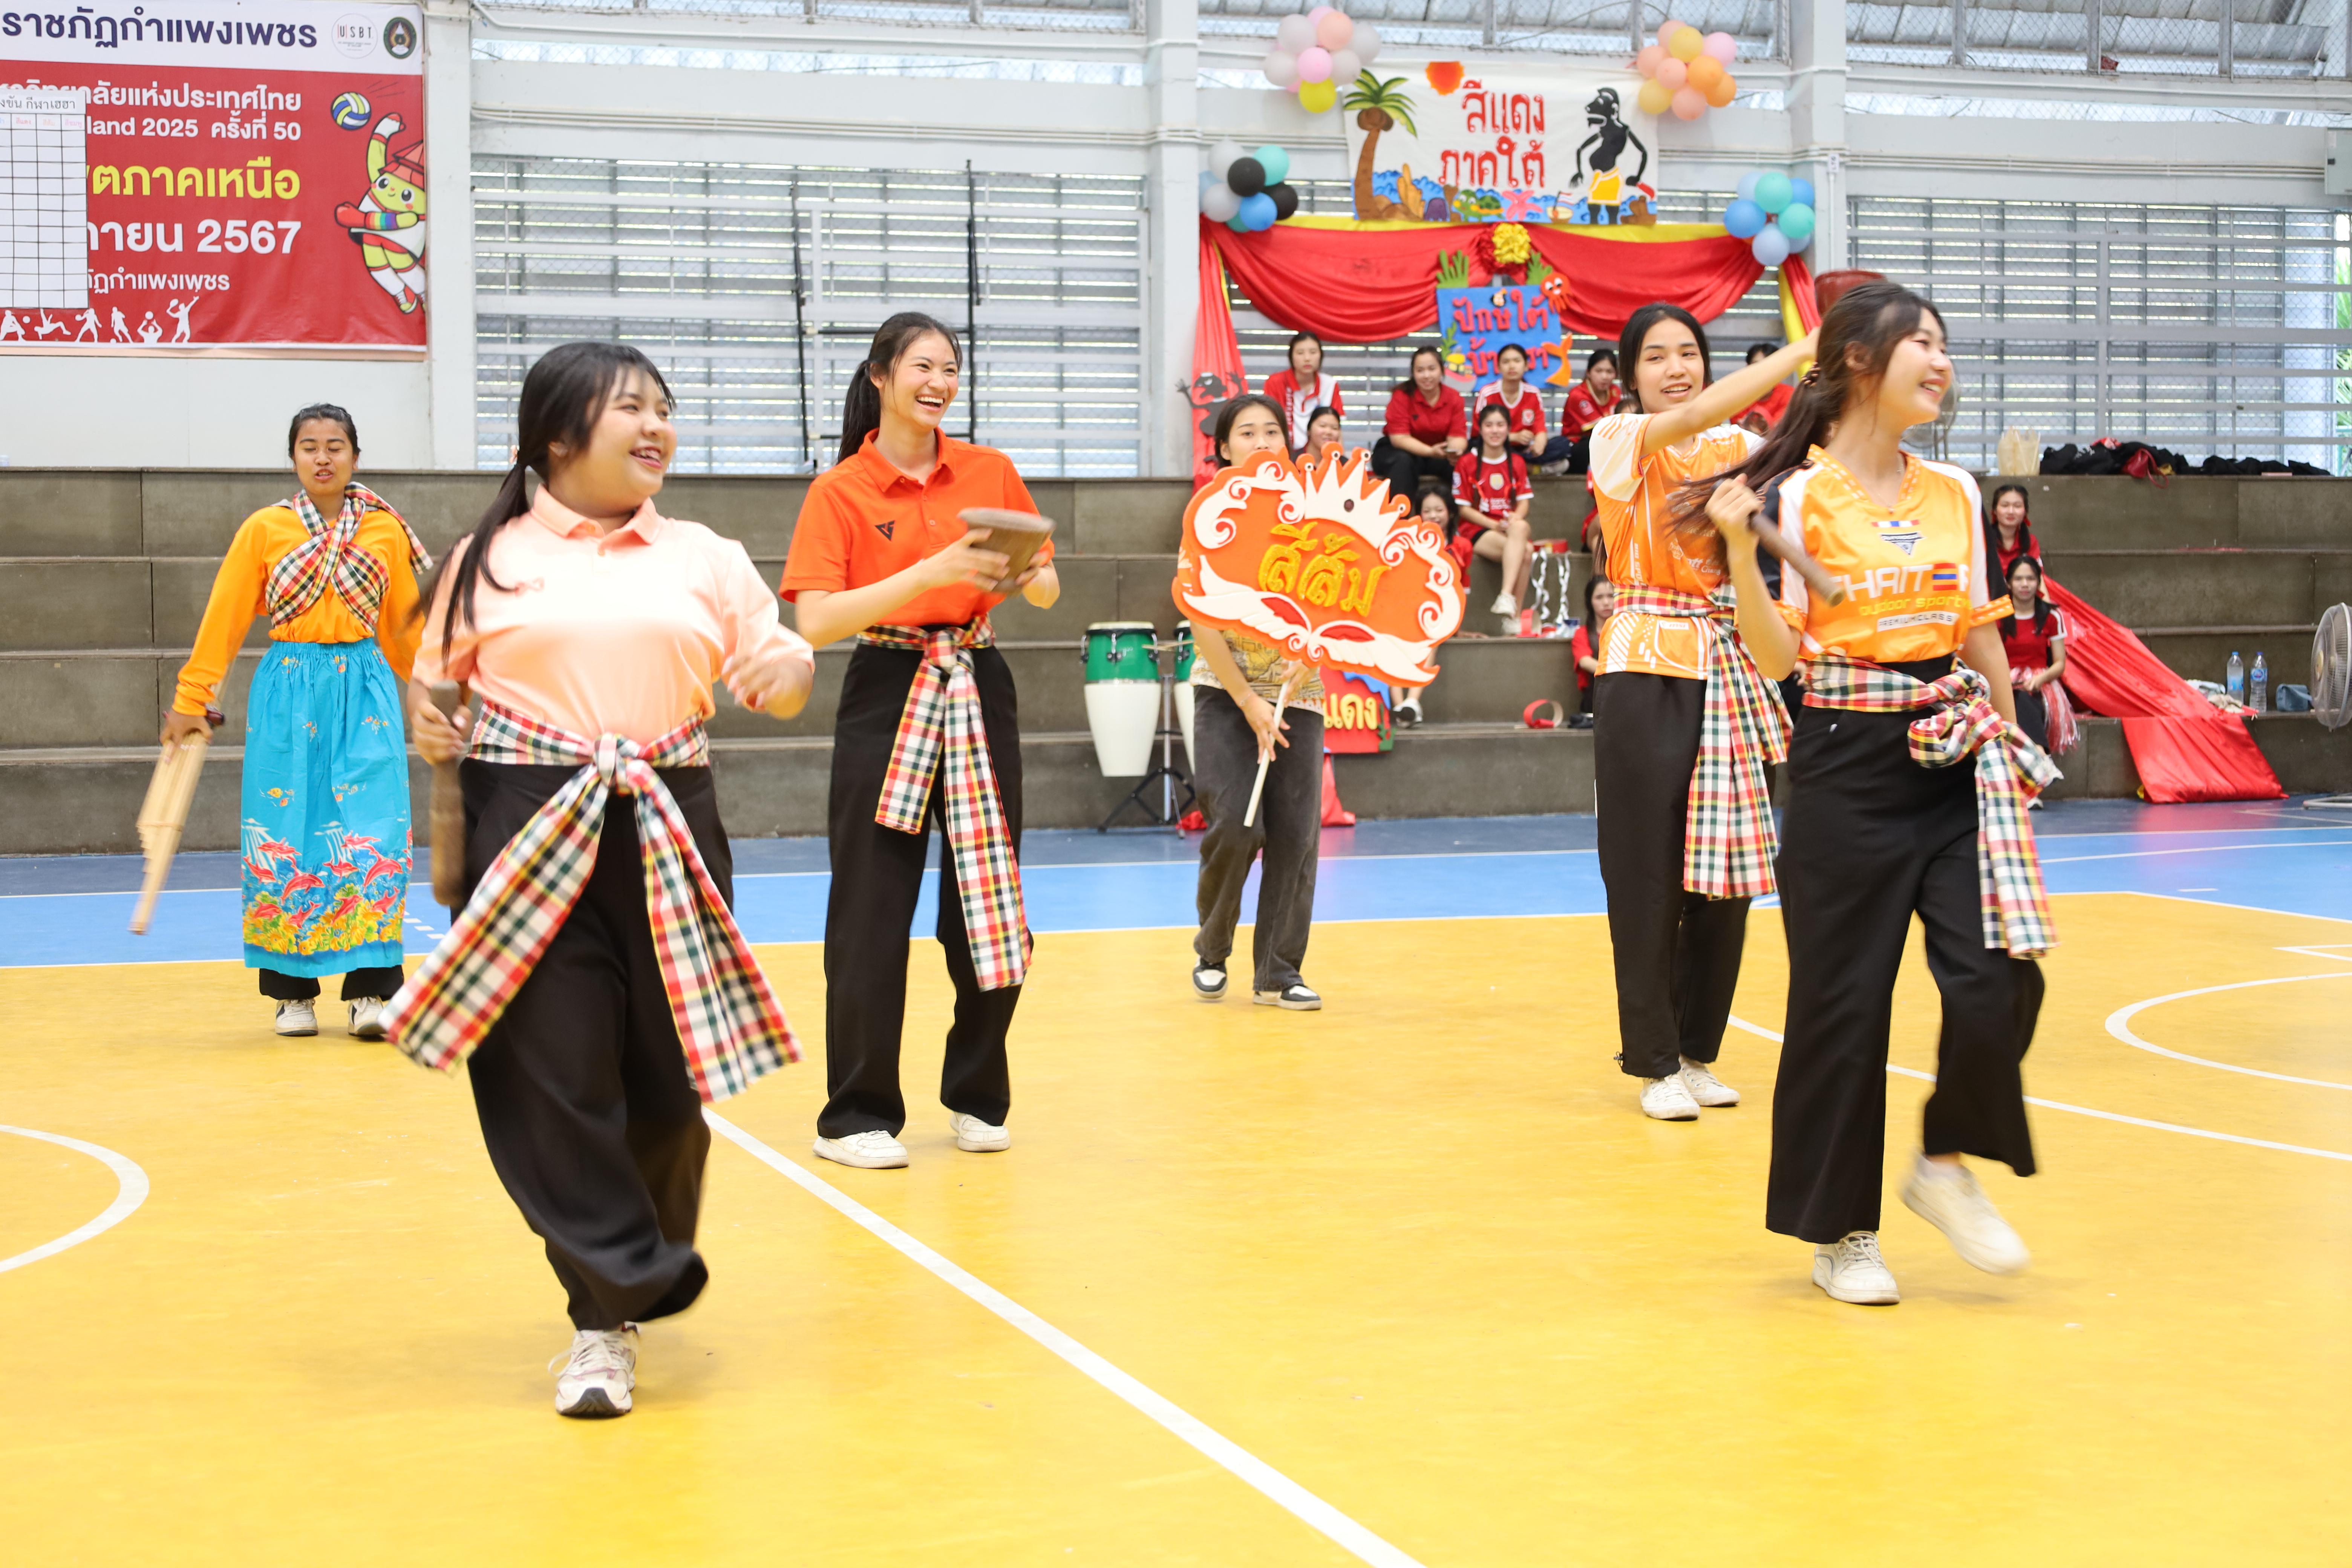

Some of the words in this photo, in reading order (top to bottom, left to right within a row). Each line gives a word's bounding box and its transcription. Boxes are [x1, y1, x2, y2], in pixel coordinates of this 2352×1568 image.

[2, 6, 317, 48] ราชภัฏกำแพงเพชร
[142, 118, 198, 137] 2025
[211, 110, 267, 139] ครั้งที่
[274, 122, 301, 141] 50
[1462, 79, 1544, 134] สีแดง
[87, 156, 300, 199] ตภาคเหนือ
[1438, 135, 1545, 188] ภาคใต้
[197, 219, 301, 254] 2567
[1258, 521, 1392, 617] สีส้ม
[1323, 693, 1378, 730] แดง
